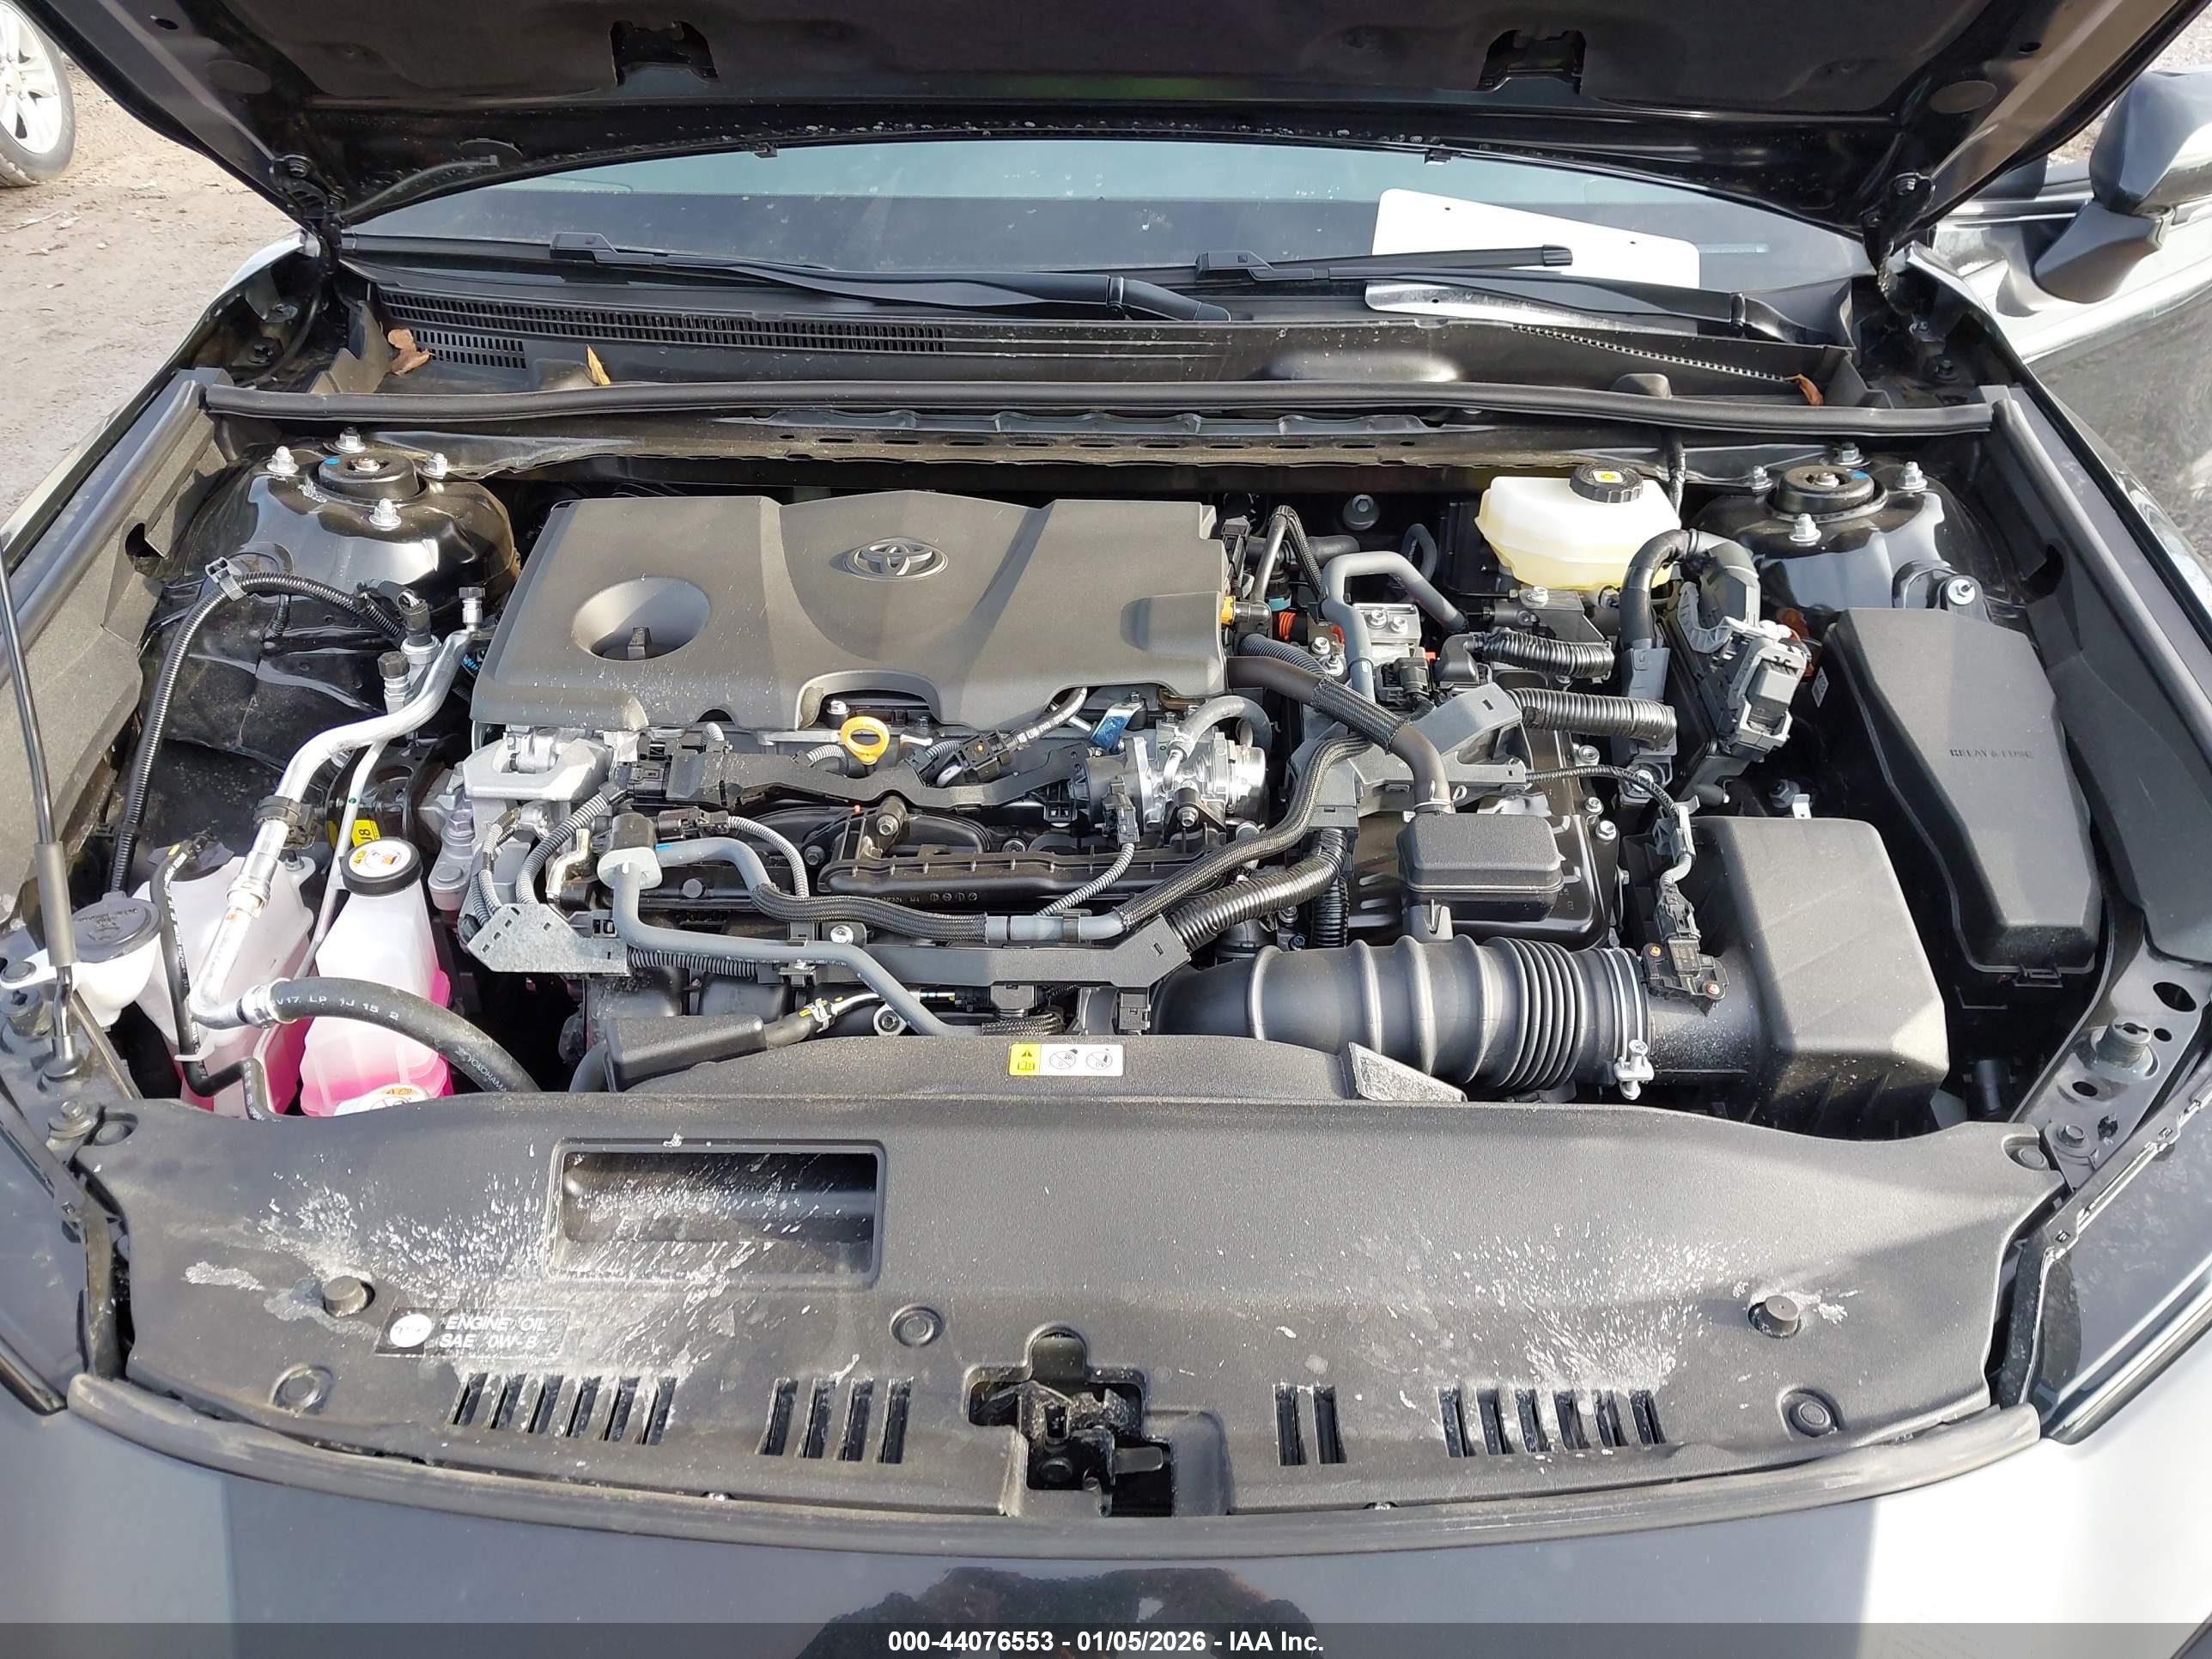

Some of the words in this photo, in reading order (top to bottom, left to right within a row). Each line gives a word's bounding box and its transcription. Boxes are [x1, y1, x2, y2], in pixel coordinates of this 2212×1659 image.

[445, 1316, 511, 1330] ENGINE
[520, 1317, 548, 1332] OIL
[439, 1334, 477, 1348] SAE
